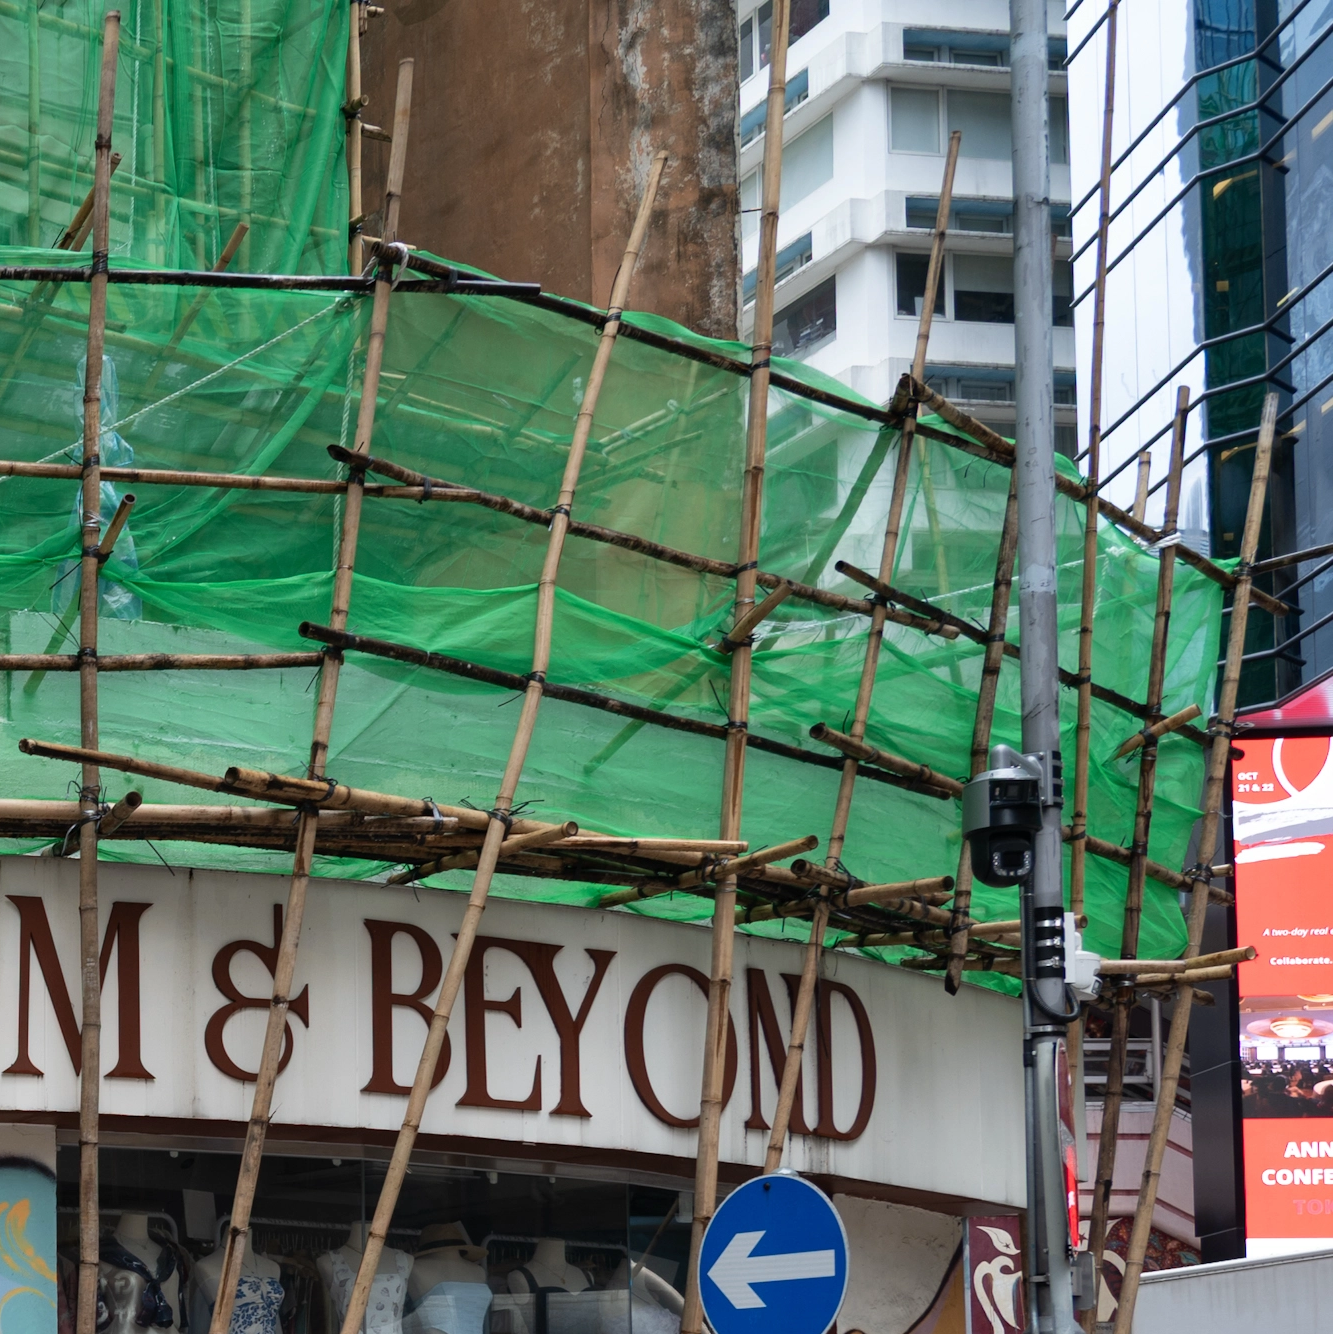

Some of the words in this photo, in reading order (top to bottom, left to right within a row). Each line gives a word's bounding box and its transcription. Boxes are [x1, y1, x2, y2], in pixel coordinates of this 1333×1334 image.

[1238, 772, 1258, 780] OCT
[1238, 784, 1249, 792] 21
[1251, 784, 1261, 792] &
[1262, 784, 1274, 792] 22
[1263, 928, 1270, 936] A
[1271, 928, 1309, 938] two-day
[204, 904, 310, 1082] &
[360, 919, 877, 1142] BEYOND
